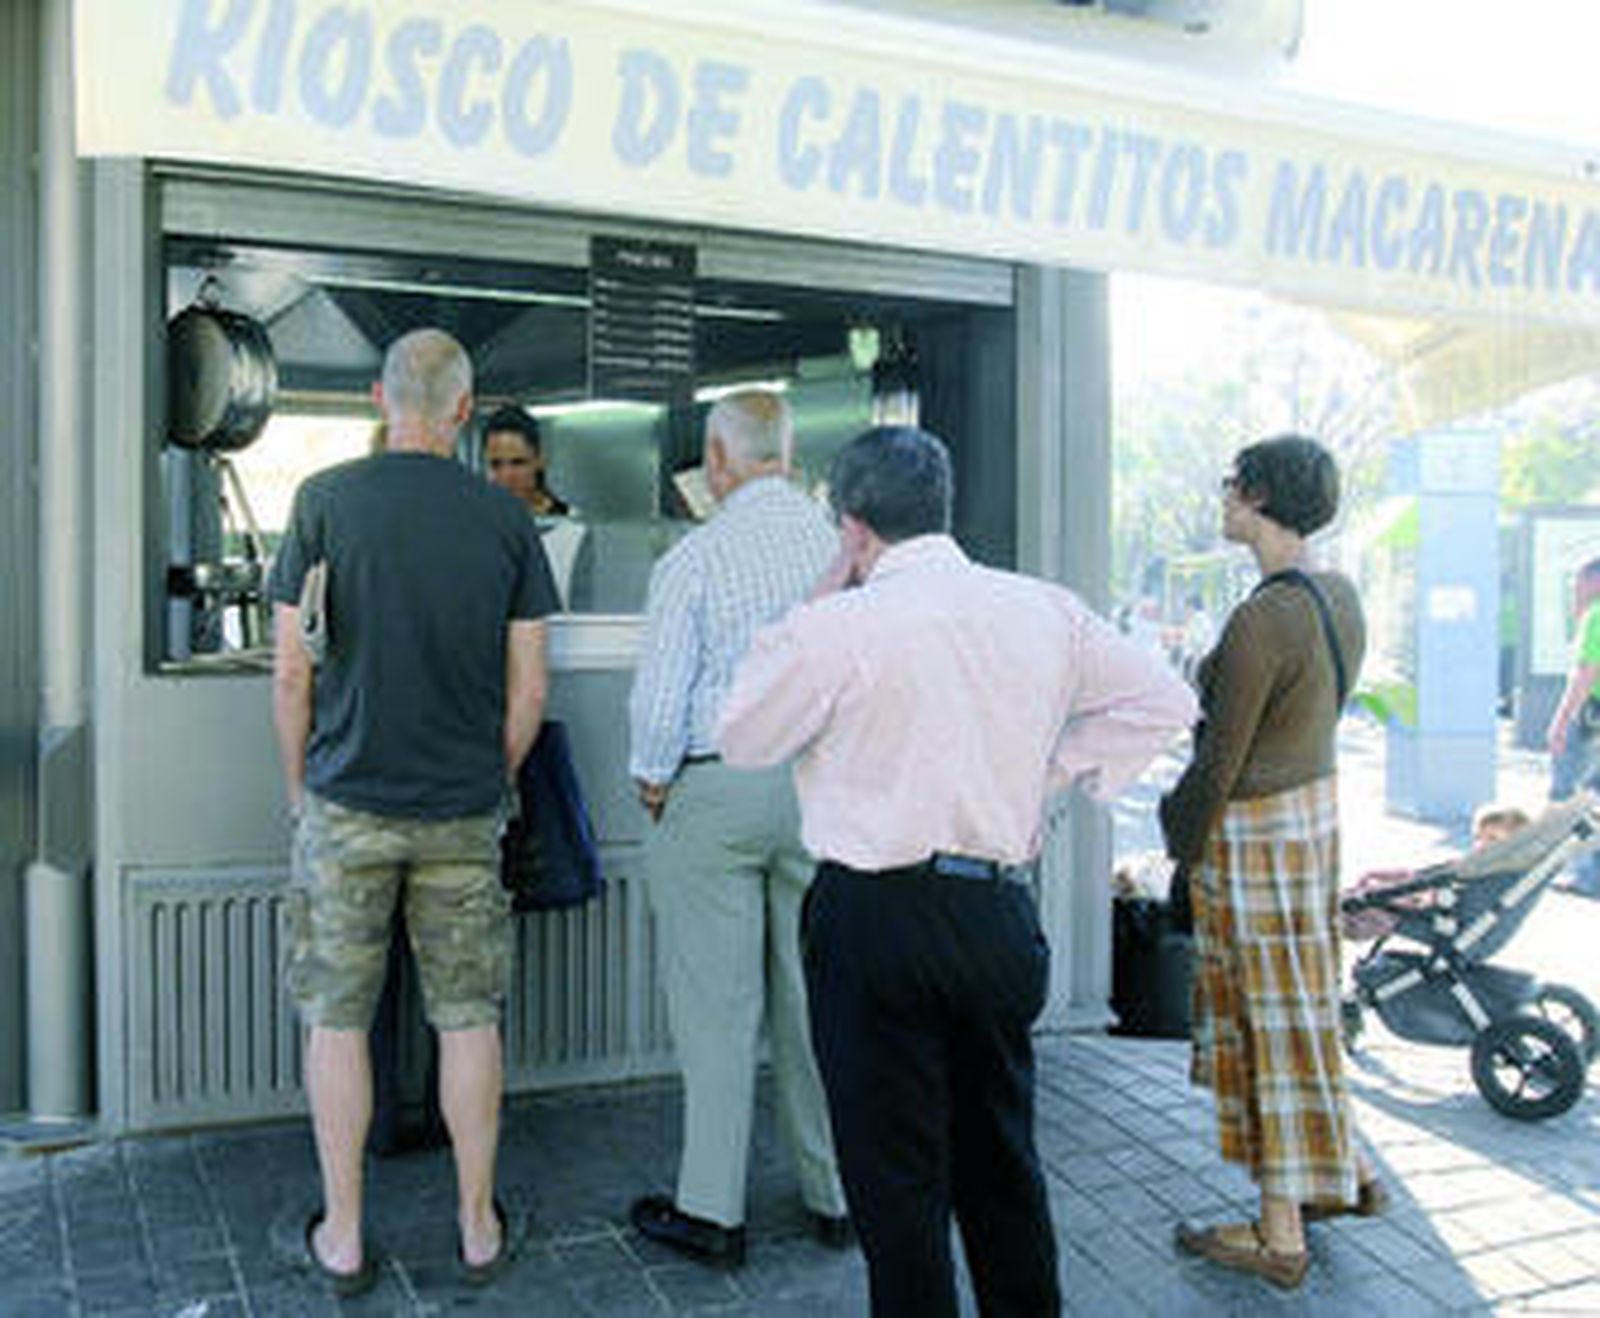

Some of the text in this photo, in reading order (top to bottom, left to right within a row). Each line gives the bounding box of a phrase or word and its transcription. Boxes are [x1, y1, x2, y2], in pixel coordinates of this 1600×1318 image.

[165, 0, 1600, 293] KIOSCO DE CALENTITOS MACARENA
